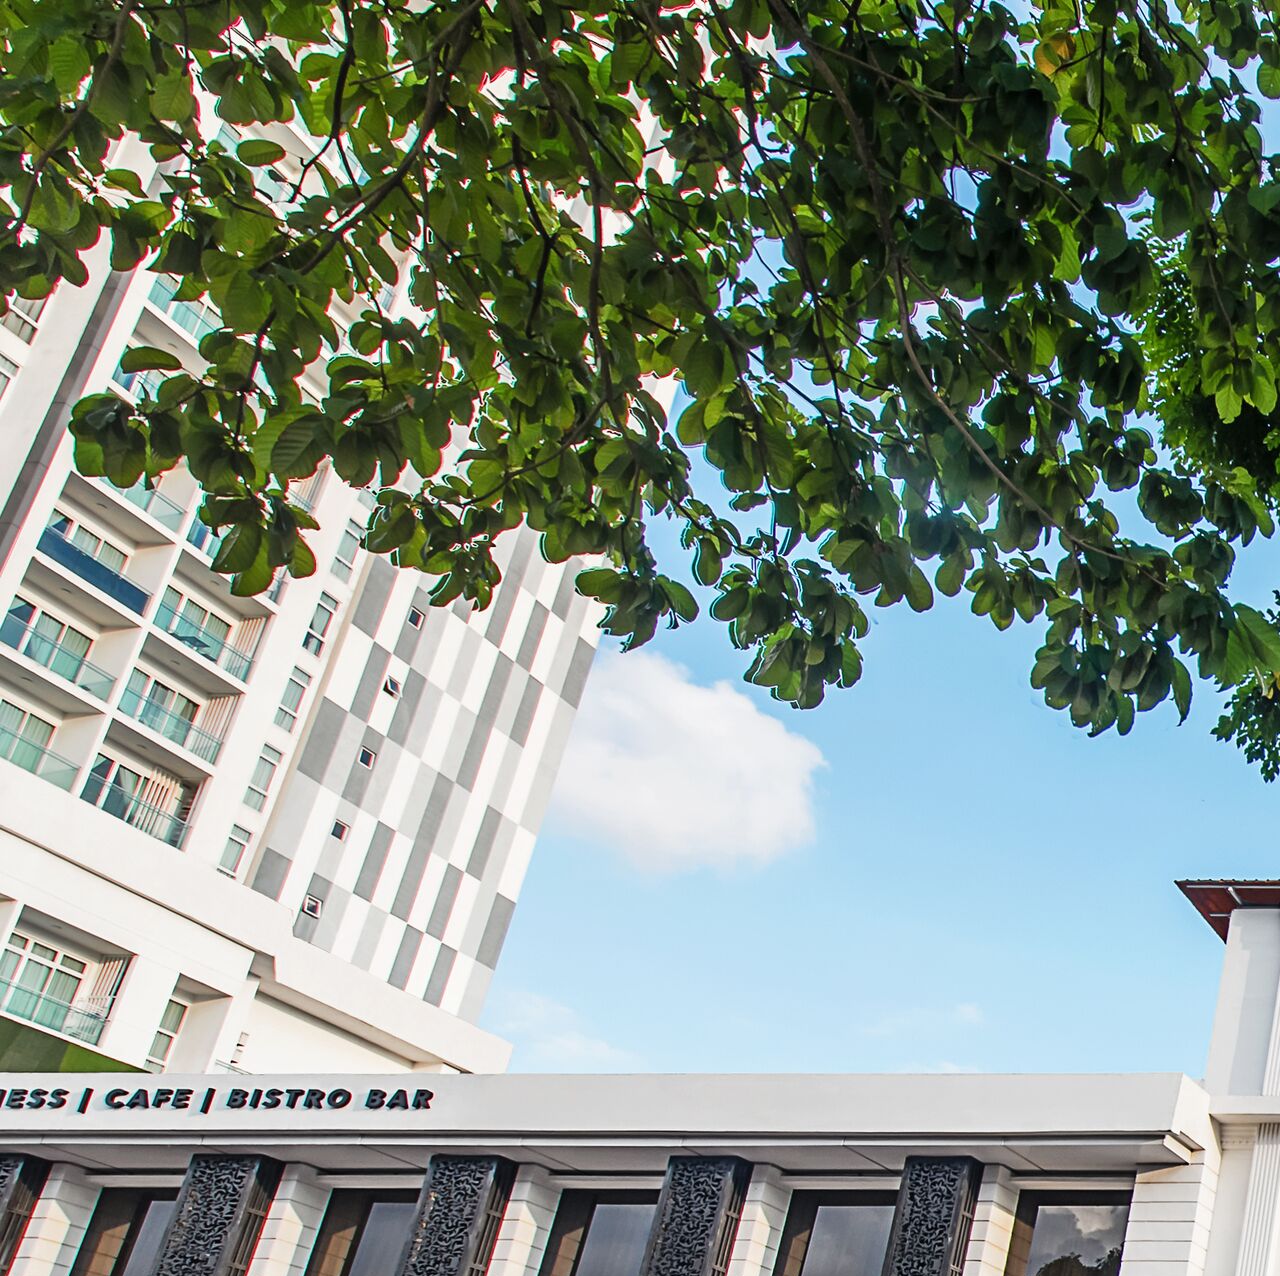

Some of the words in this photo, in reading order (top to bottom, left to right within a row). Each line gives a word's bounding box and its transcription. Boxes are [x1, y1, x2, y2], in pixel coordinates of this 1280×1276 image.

[105, 1087, 194, 1110] CAFE
[226, 1087, 352, 1110] BISTRO
[364, 1087, 433, 1110] BAR
